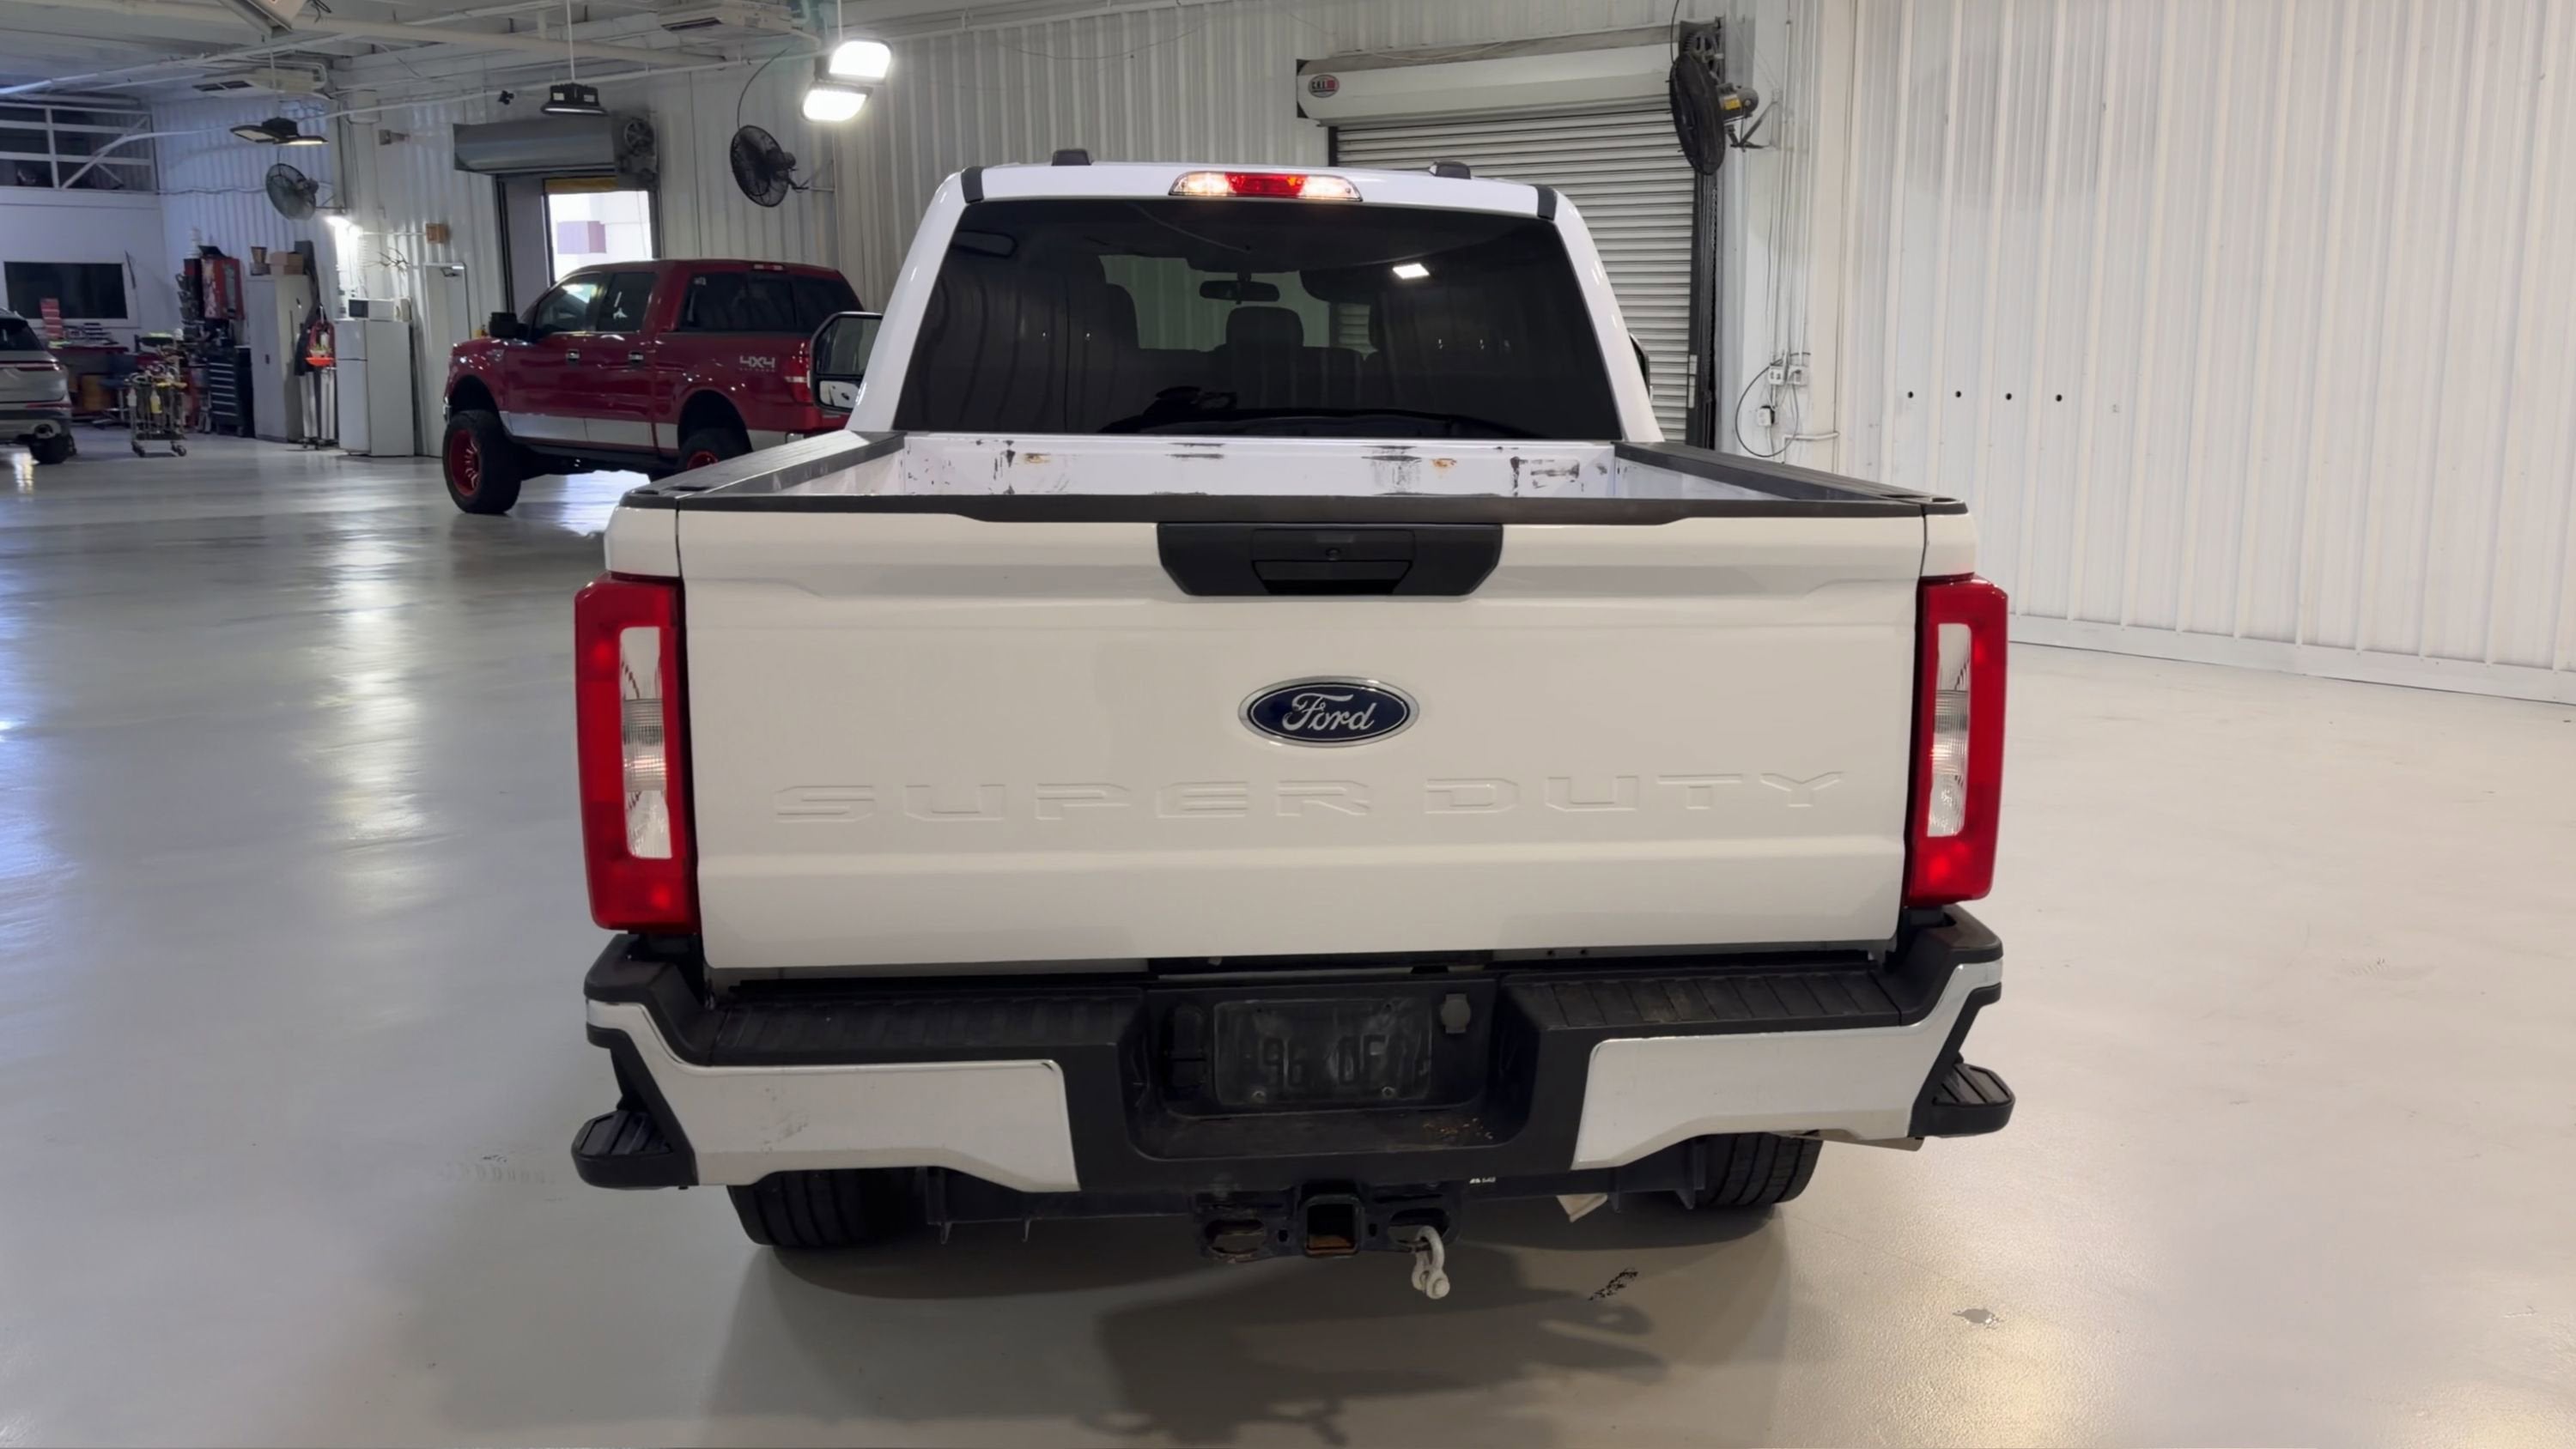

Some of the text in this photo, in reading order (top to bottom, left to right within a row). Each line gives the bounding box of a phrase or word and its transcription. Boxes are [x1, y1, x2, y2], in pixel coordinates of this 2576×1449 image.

[1281, 692, 1377, 731] Ford
[775, 772, 1844, 822] SUPER DUTY
